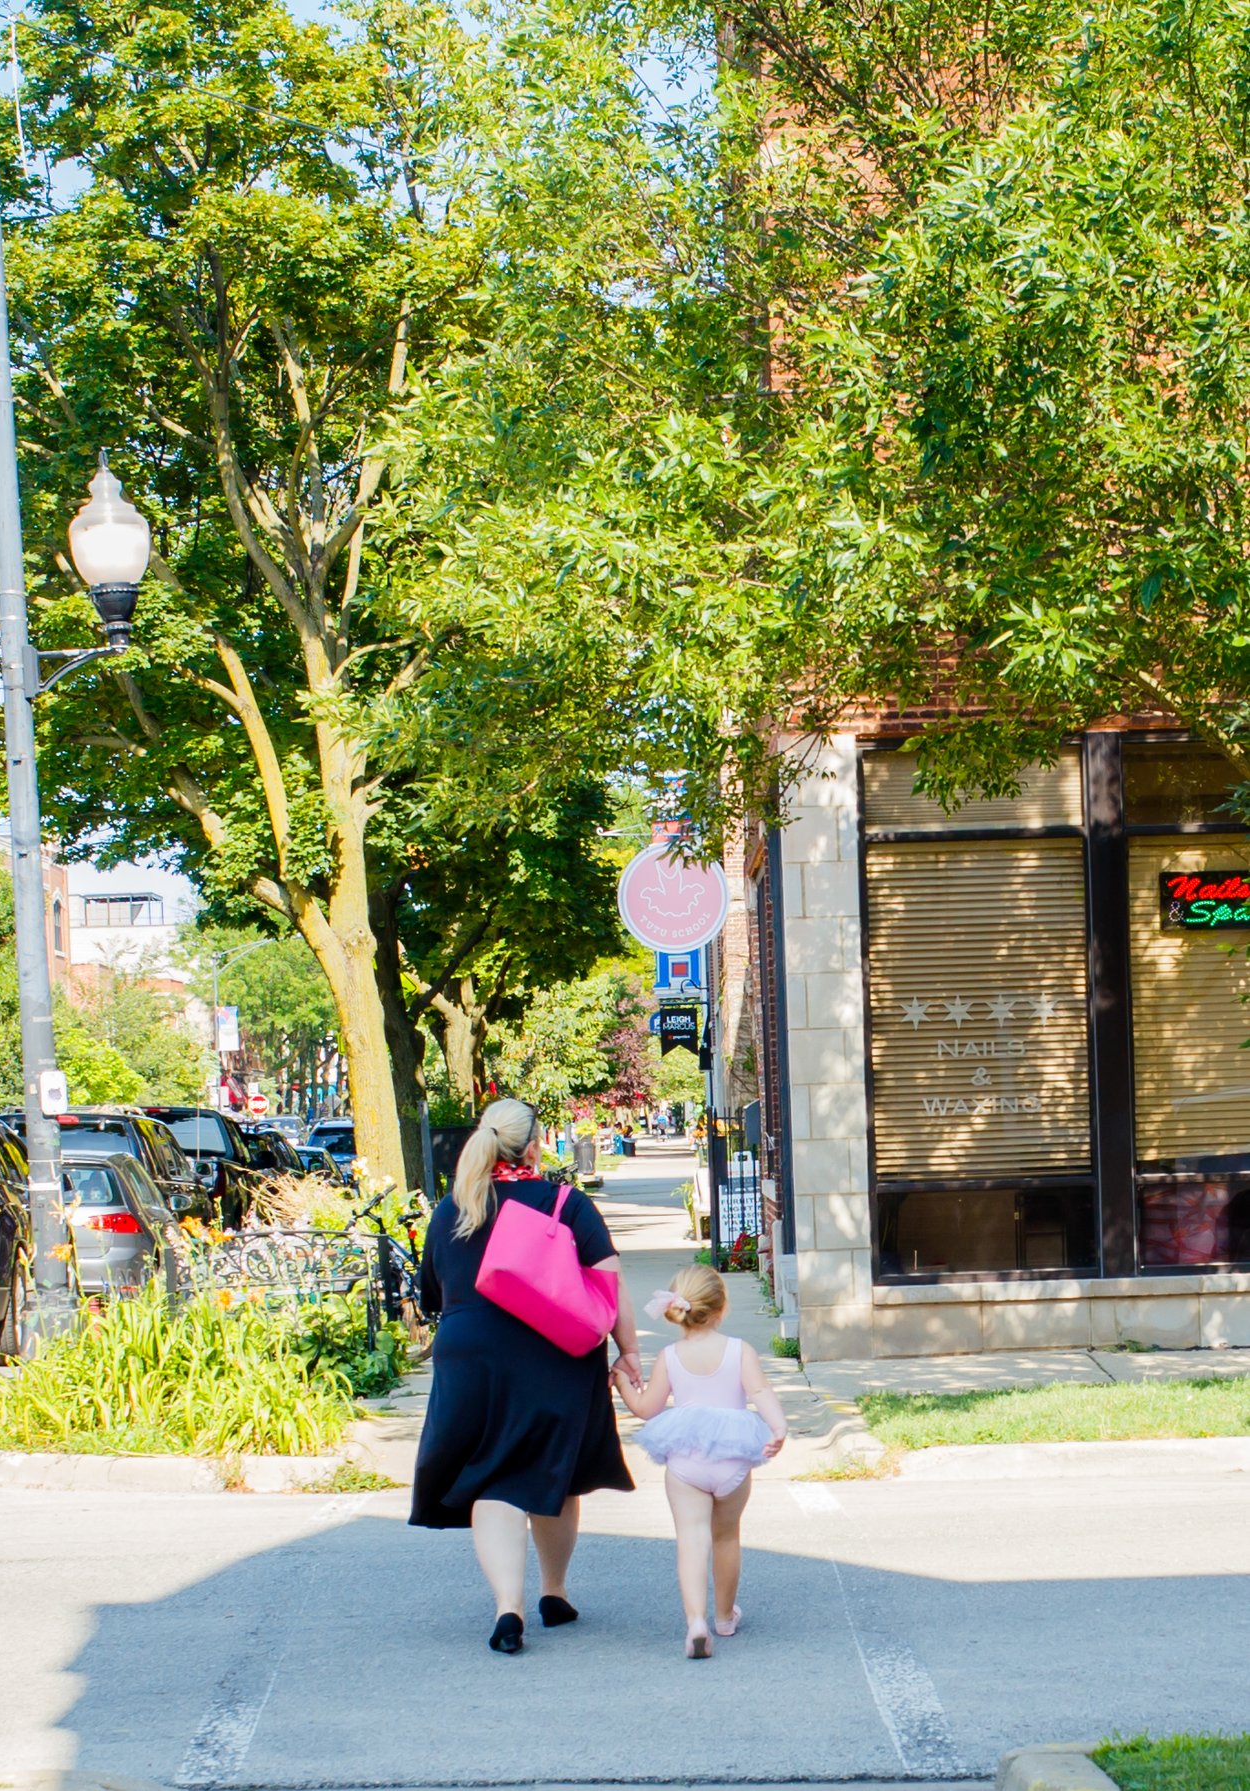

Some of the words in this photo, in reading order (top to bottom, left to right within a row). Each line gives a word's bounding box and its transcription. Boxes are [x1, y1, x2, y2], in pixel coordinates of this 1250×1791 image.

[640, 914, 668, 937] TUTU
[671, 912, 712, 938] SCHOOL
[662, 1022, 696, 1030] MARCUS
[666, 1015, 692, 1024] LEIGH
[937, 1039, 1026, 1058] NAILS
[971, 1066, 992, 1086] &
[922, 1095, 1042, 1116] WAXING
